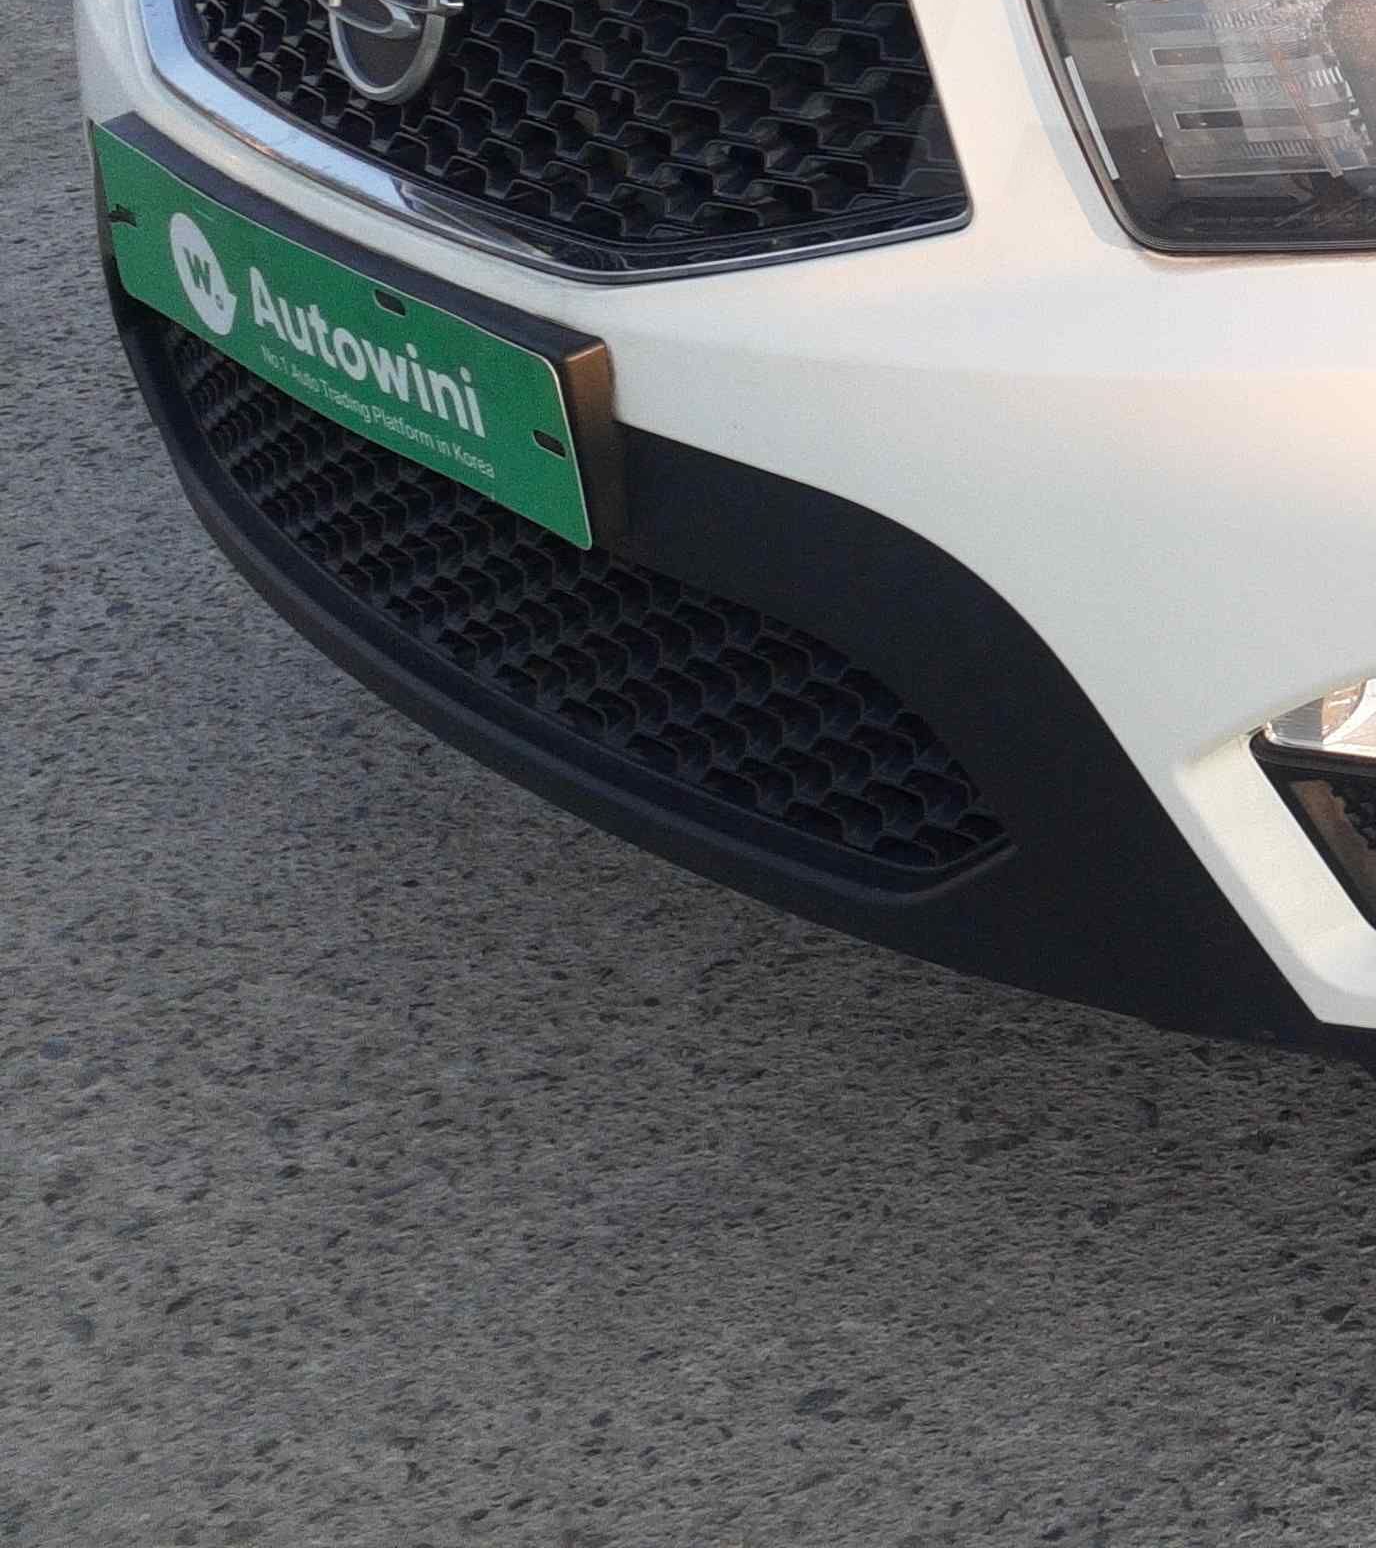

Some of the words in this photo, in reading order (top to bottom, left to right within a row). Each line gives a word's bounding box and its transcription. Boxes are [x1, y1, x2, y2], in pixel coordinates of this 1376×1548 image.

[249, 266, 486, 439] Autowini
[318, 379, 372, 424] Trading
[370, 405, 435, 449] Platform
[436, 436, 451, 455] in
[452, 444, 496, 479] Korea
